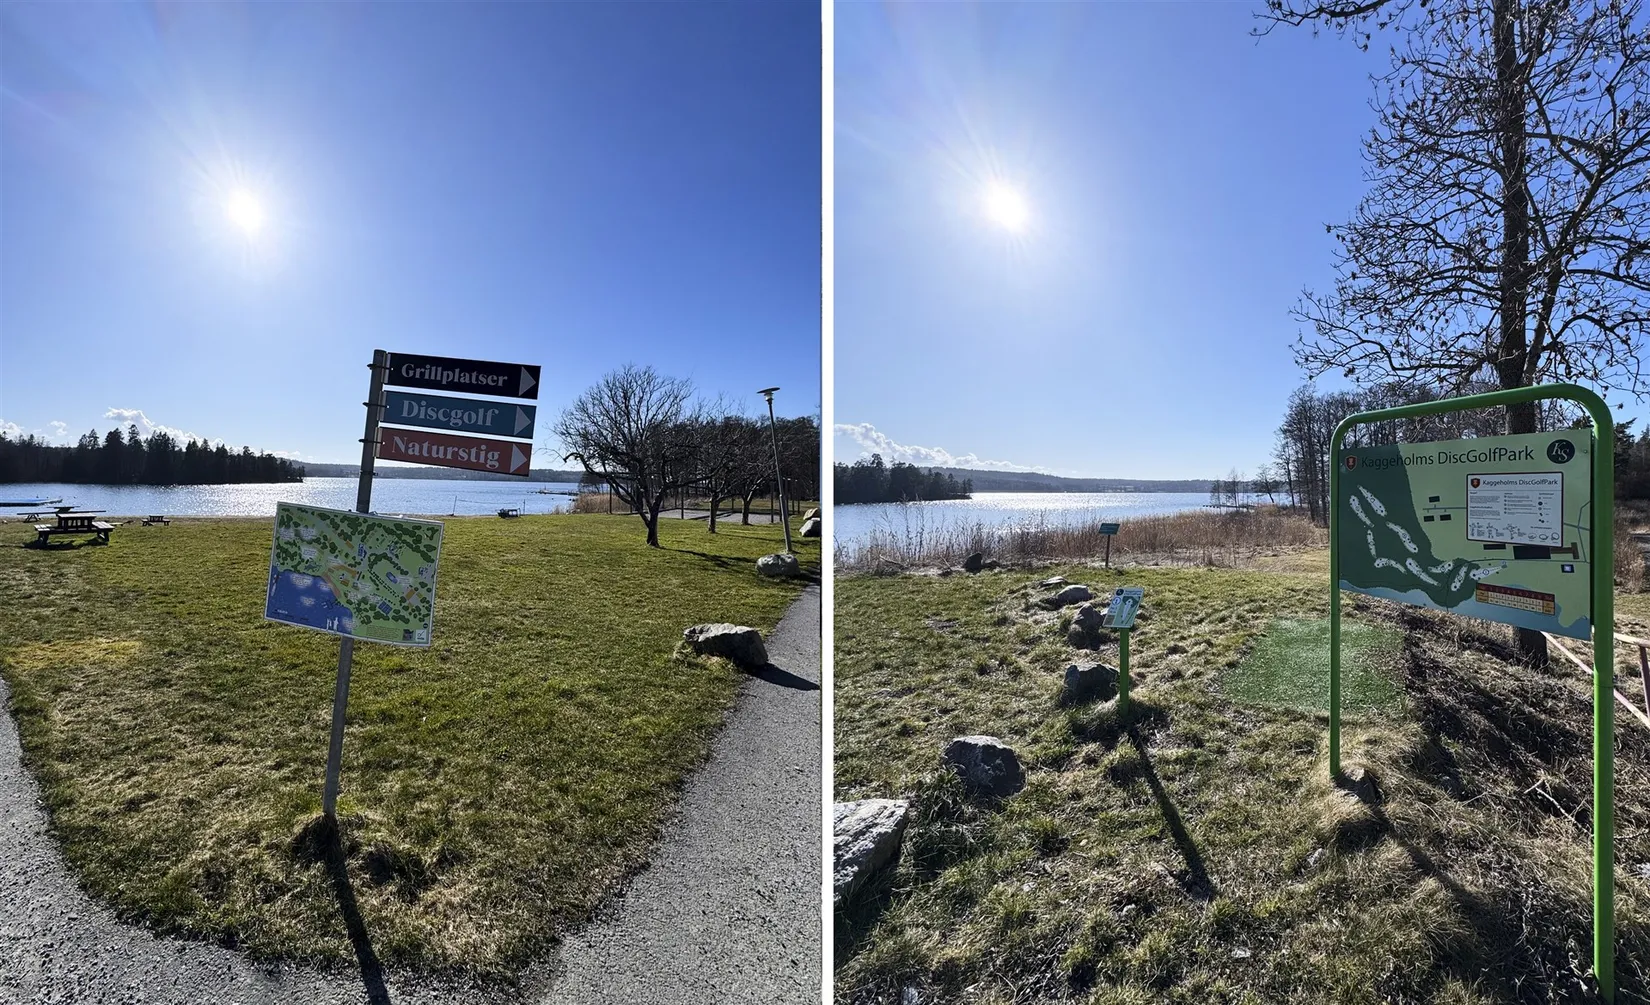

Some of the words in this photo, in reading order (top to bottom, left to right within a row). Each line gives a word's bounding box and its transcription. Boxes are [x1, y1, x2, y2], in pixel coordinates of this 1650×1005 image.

[401, 363, 508, 387] Grillplatser
[401, 399, 499, 427] Discgolf
[391, 436, 500, 469] Naturstig
[1361, 453, 1434, 470] Kaggeholms
[1438, 445, 1534, 464] DiscGolfPark
[1482, 479, 1517, 487] Kaggeholms
